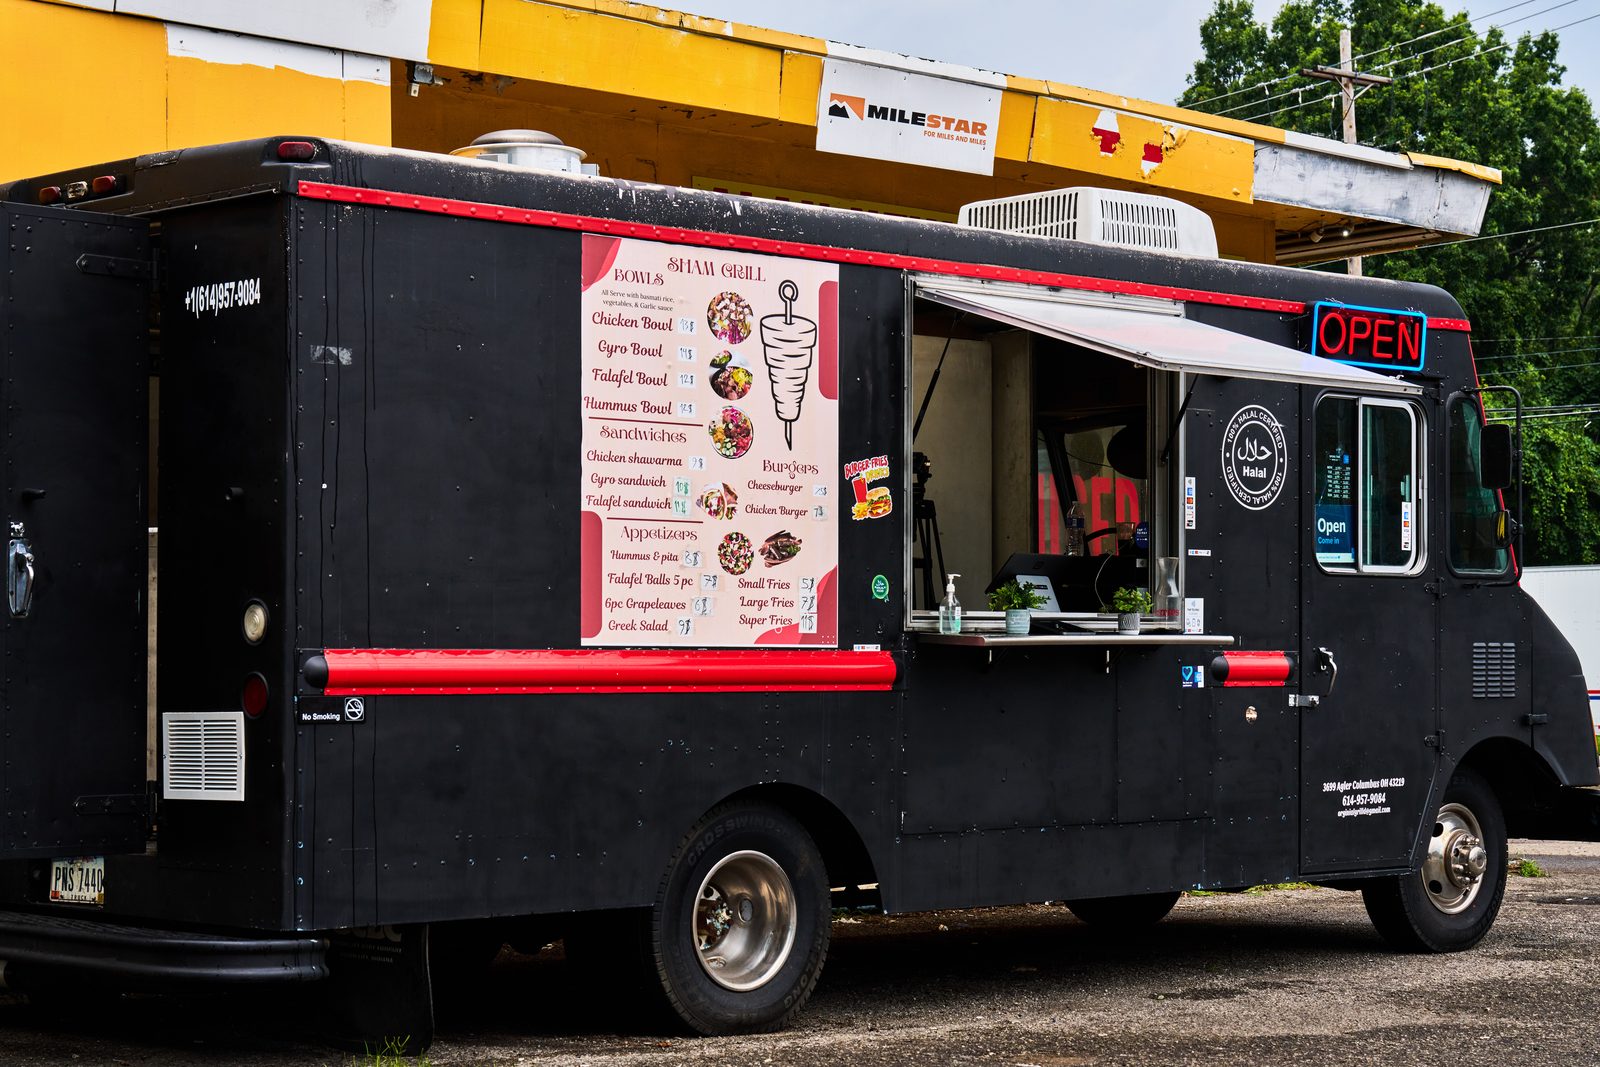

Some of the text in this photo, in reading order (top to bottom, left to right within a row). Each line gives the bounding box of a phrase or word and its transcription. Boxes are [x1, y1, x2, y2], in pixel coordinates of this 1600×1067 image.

[867, 104, 988, 136] MILESTAR
[937, 132, 954, 140] MILES
[956, 135, 968, 143] AND
[969, 136, 986, 146] MILES
[614, 268, 664, 286] BOWLS
[667, 257, 766, 282] SHAM GRILL
[185, 278, 260, 319] +1(614)957-9084
[602, 300, 633, 308] vegetables,
[640, 292, 662, 302] basmati
[592, 311, 674, 331] Chicken Bowl
[1319, 312, 1420, 360] OPEN
[598, 340, 663, 358] Gyro Bowl
[592, 368, 668, 388] Falafel Bowl
[584, 396, 672, 414] Hummus Bowl
[600, 425, 687, 444] Sandwiches
[1228, 410, 1283, 449] 100% HALAL CERTIFIED
[1238, 437, 1272, 462] حلال
[586, 450, 682, 466] Chicken shawarma
[762, 459, 819, 480] Burgers
[1242, 466, 1266, 478] Halal
[590, 472, 666, 488] Gyro sandwich
[748, 480, 803, 495] Cheeseburger
[1226, 466, 1282, 504] 100% HALAL CERTIFIED
[586, 494, 672, 511] Falafel sandwich
[745, 504, 808, 519] Chicken Burger
[620, 526, 698, 542] Appetizers
[1318, 518, 1346, 536] Open
[1318, 536, 1340, 544] Come in
[610, 550, 679, 564] Hummus & pita
[608, 572, 694, 590] Falafel Balls 5 pc
[738, 578, 790, 590] Small Fries
[605, 598, 686, 614] 6pc Grapeleaves
[740, 596, 794, 611] Large Fries
[608, 619, 668, 632] Greek Salad
[738, 614, 792, 629] Super Fries
[312, 712, 340, 722] Smoking
[1336, 780, 1352, 792] Agler
[1352, 778, 1380, 790] Columbus
[1380, 778, 1389, 788] OH
[1389, 778, 1405, 787] 43219
[1342, 792, 1386, 806] 614-957-9084
[54, 866, 103, 892] PNS 7440
